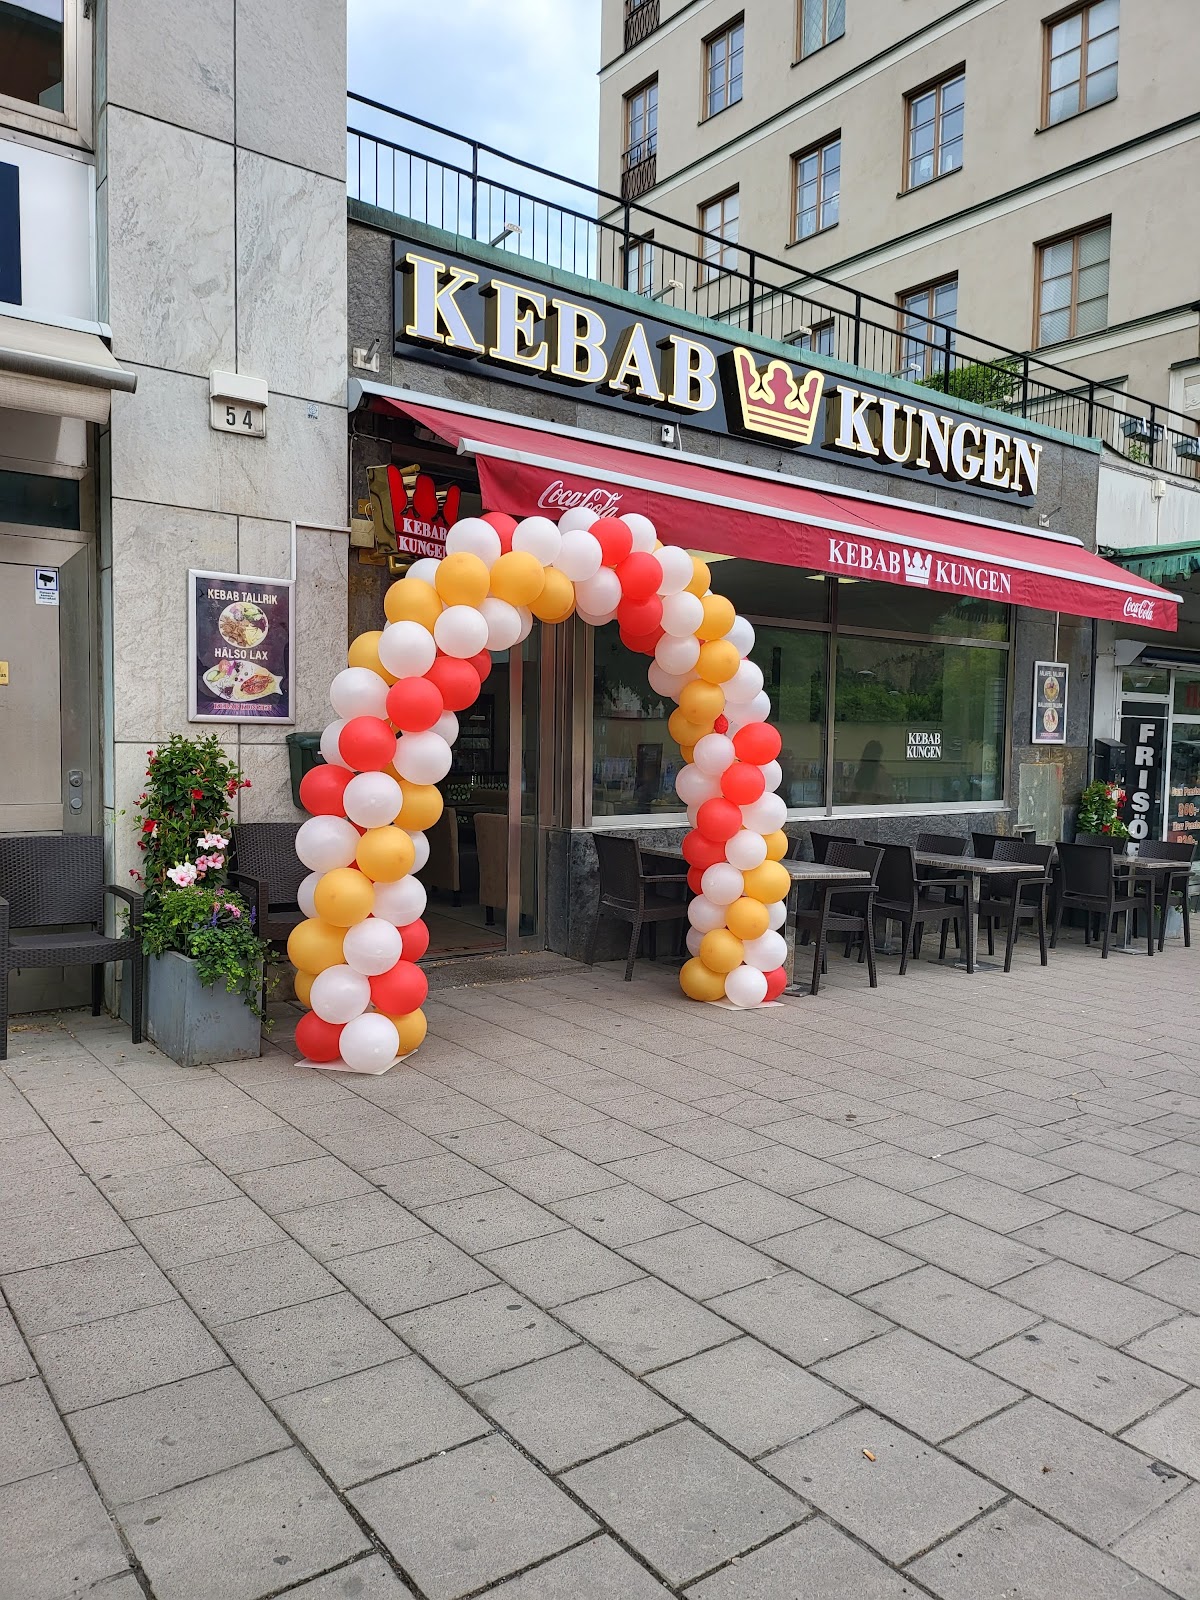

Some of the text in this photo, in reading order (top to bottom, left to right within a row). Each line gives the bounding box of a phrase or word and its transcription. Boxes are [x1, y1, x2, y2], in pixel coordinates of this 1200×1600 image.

[405, 252, 1043, 496] KEBAB KUNGEN
[226, 405, 253, 429] 54
[402, 517, 447, 541] KEBAB
[828, 538, 1012, 595] KEBAB KUNGEN
[207, 588, 278, 605] KEBAB TALLRIK
[1123, 596, 1156, 621] Coca-Cola
[214, 646, 269, 661] HÄLSO LAX
[908, 732, 941, 745] KEBAB
[906, 745, 942, 758] KUNGEN
